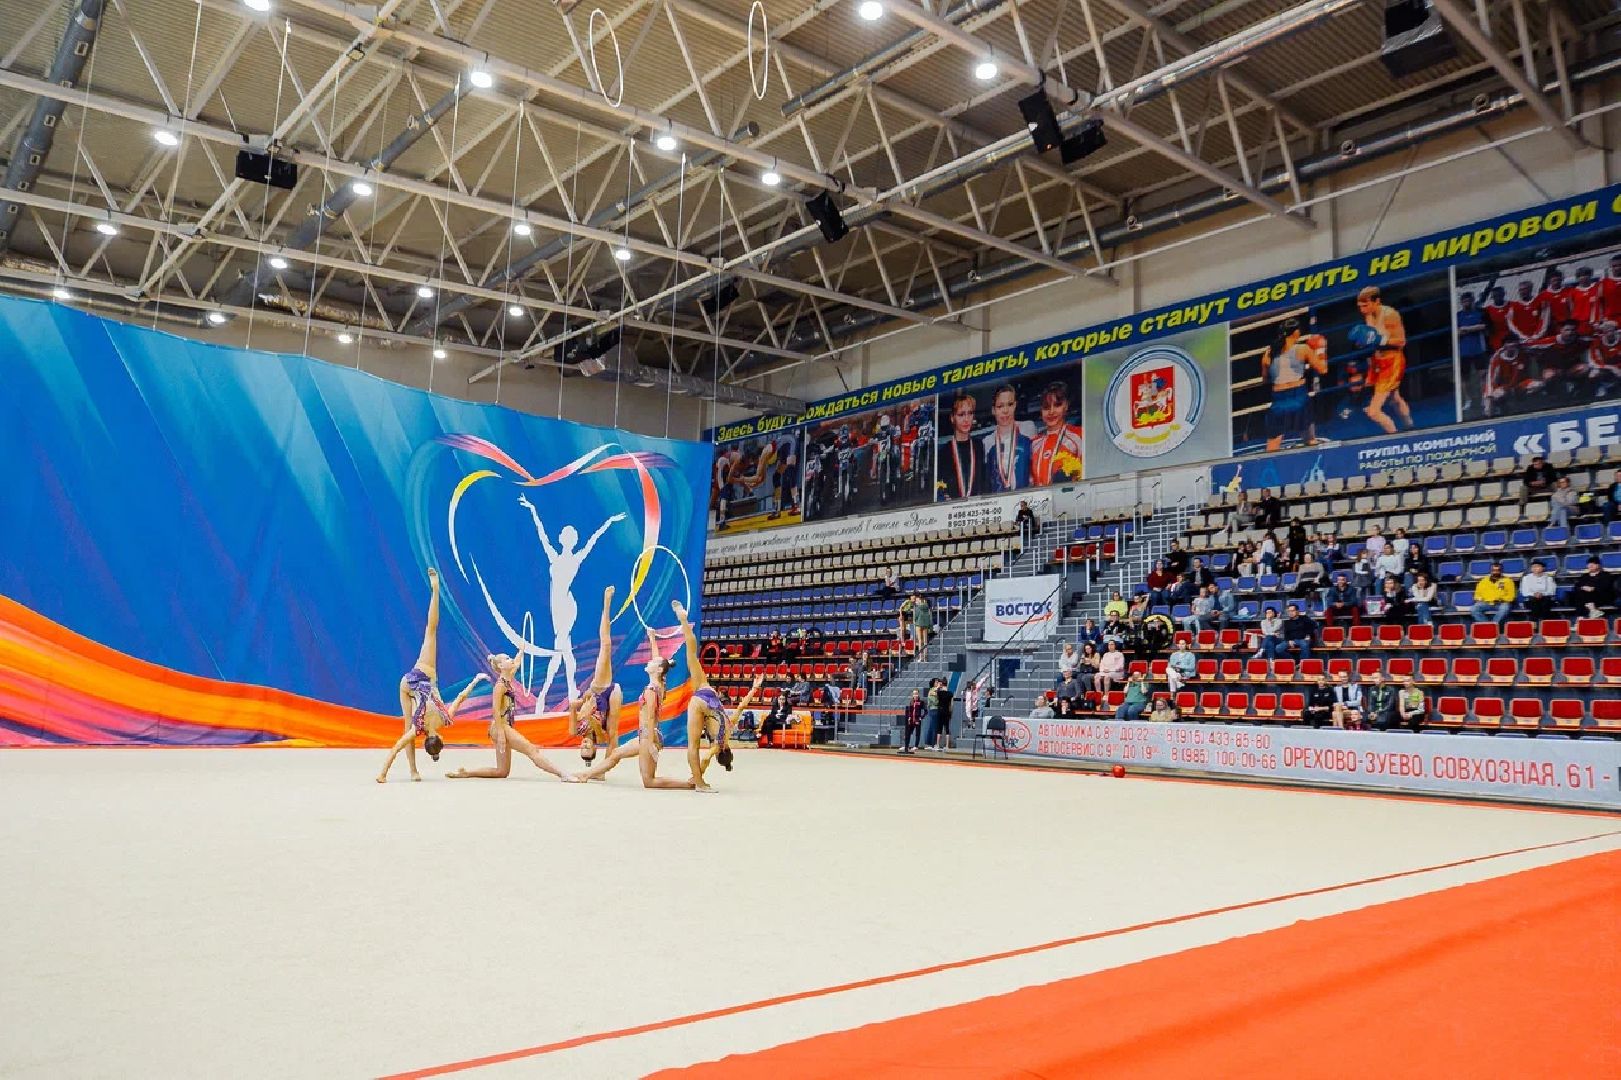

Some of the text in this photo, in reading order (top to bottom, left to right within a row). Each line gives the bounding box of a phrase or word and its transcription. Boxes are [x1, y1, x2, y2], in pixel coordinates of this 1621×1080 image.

[718, 424, 753, 441] Здесь
[882, 376, 936, 400] новые
[942, 351, 1028, 382] таланты,
[1035, 322, 1133, 361] которые
[1140, 296, 1231, 335] станут
[1238, 264, 1358, 310] светить
[1369, 250, 1411, 276] на
[1422, 201, 1597, 263] мировом
[1358, 429, 1496, 459] ГРУППА КОМПАНИЙ
[1359, 457, 1404, 470] РАБОТЫ
[1405, 454, 1424, 465] ПО
[1425, 443, 1497, 461] ПОЖАРНОЙ
[1038, 724, 1092, 739] АВТОМОЙКА
[1120, 727, 1133, 741] ДО
[1208, 731, 1271, 749] 433-85-80
[1038, 741, 1095, 756] АВТОСЕРВИС
[1123, 744, 1136, 759] ДО
[1216, 751, 1277, 770] 100-00-66
